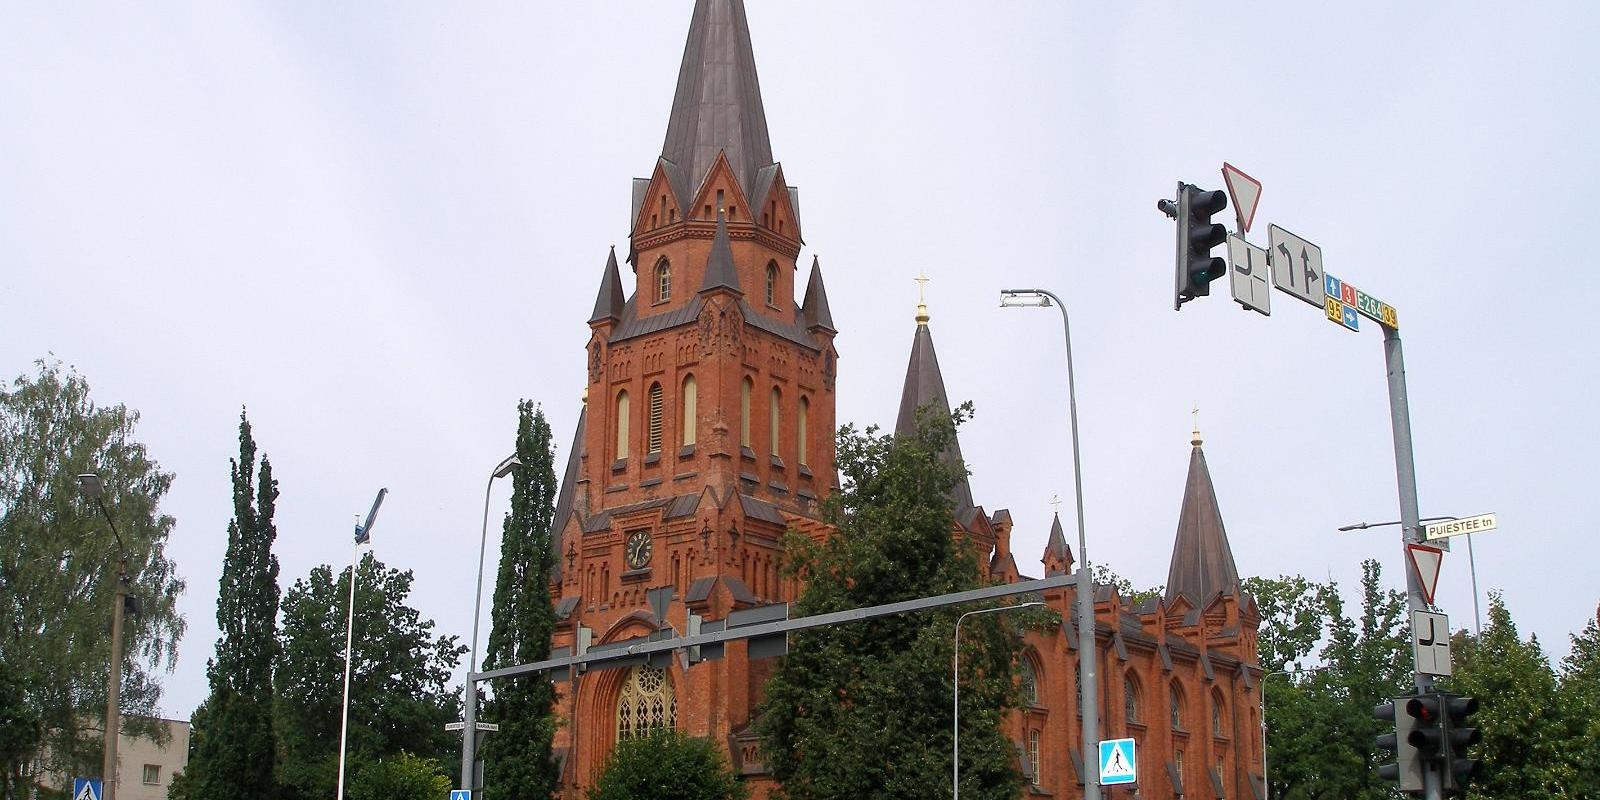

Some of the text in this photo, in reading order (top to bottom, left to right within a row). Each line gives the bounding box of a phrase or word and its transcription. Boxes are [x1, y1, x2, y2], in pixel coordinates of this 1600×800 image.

[1328, 299, 1342, 320] 95
[1345, 286, 1396, 325] 3 E264 39
[1429, 519, 1492, 536] PUIESTEE tn
